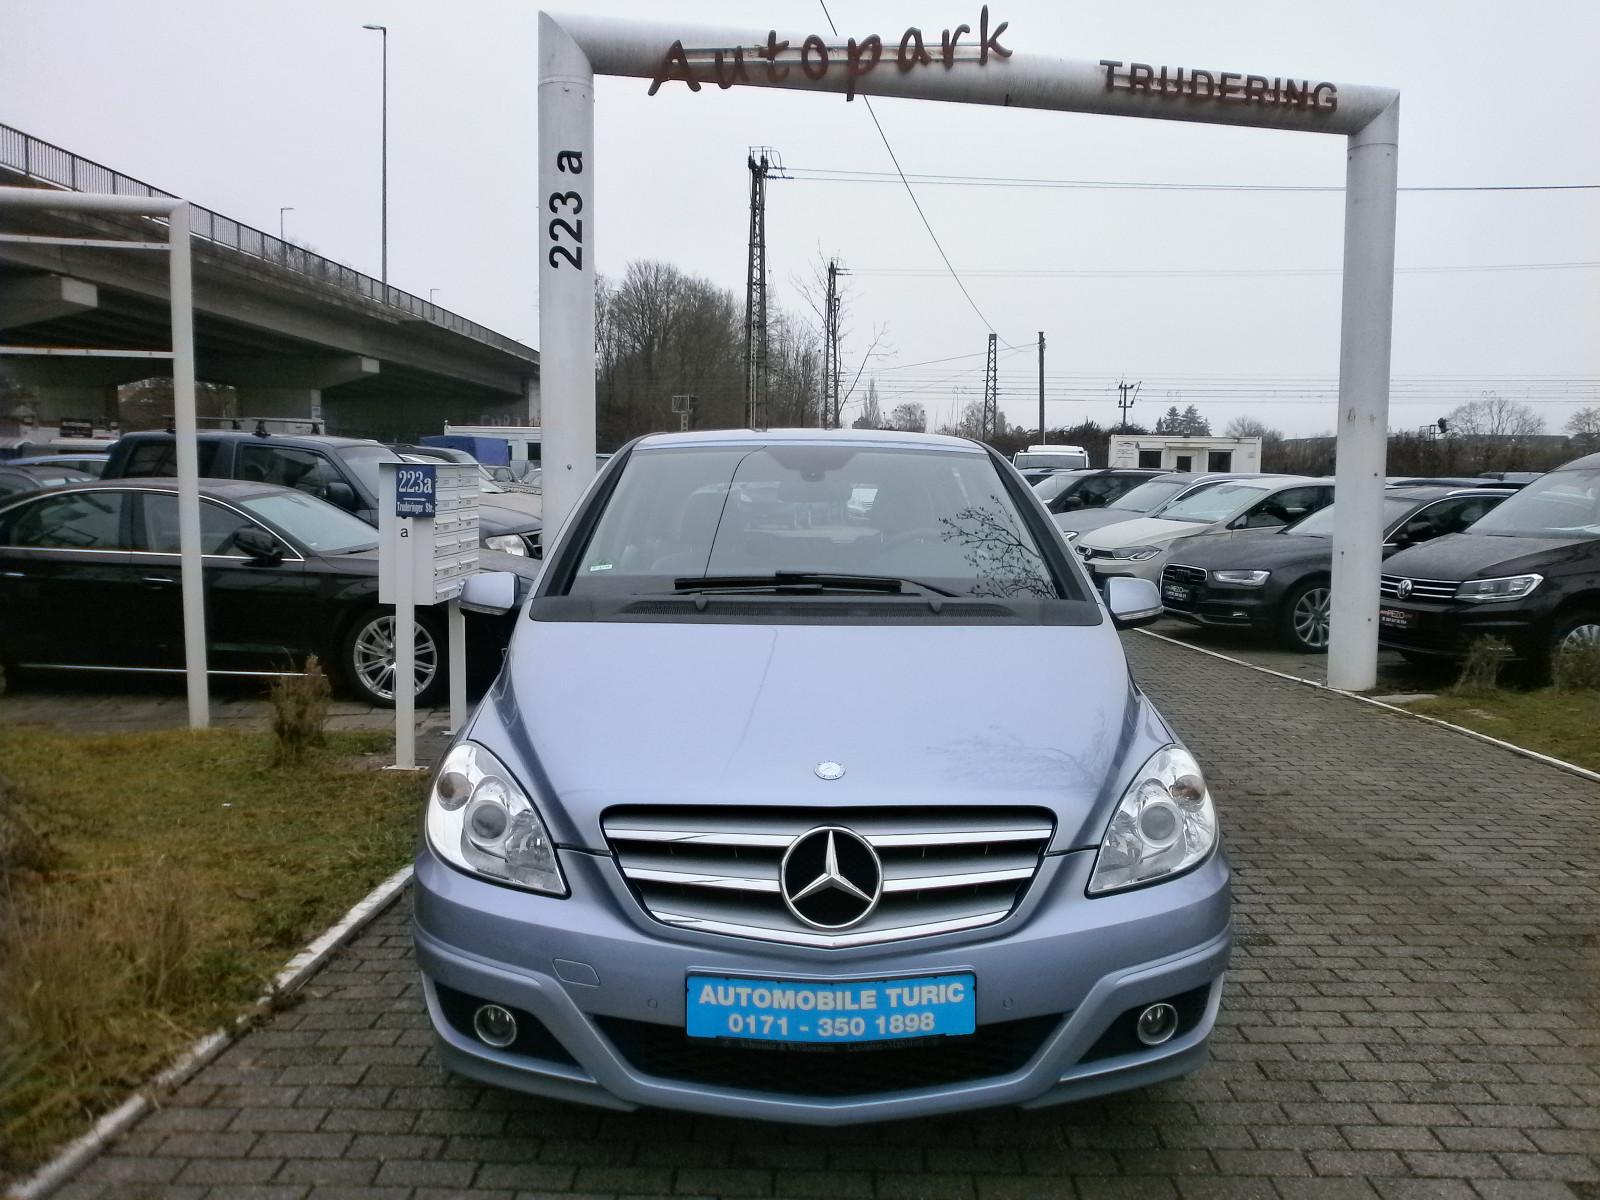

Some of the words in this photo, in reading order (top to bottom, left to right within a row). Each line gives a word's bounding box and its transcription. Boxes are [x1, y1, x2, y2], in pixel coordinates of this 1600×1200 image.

[647, 4, 1013, 102] Autopark
[1099, 59, 1338, 113] TRUDERING
[556, 150, 583, 175] a
[548, 190, 583, 271] 223
[398, 470, 432, 493] 223a
[396, 502, 423, 514] Truderinger
[425, 502, 435, 513] Str.
[400, 527, 409, 538] a
[699, 985, 878, 1011] AUTOMOBILE
[885, 983, 965, 1008] TURIC
[728, 1014, 789, 1036] 0171
[818, 1017, 866, 1037] 350
[875, 1012, 936, 1035] 1898
